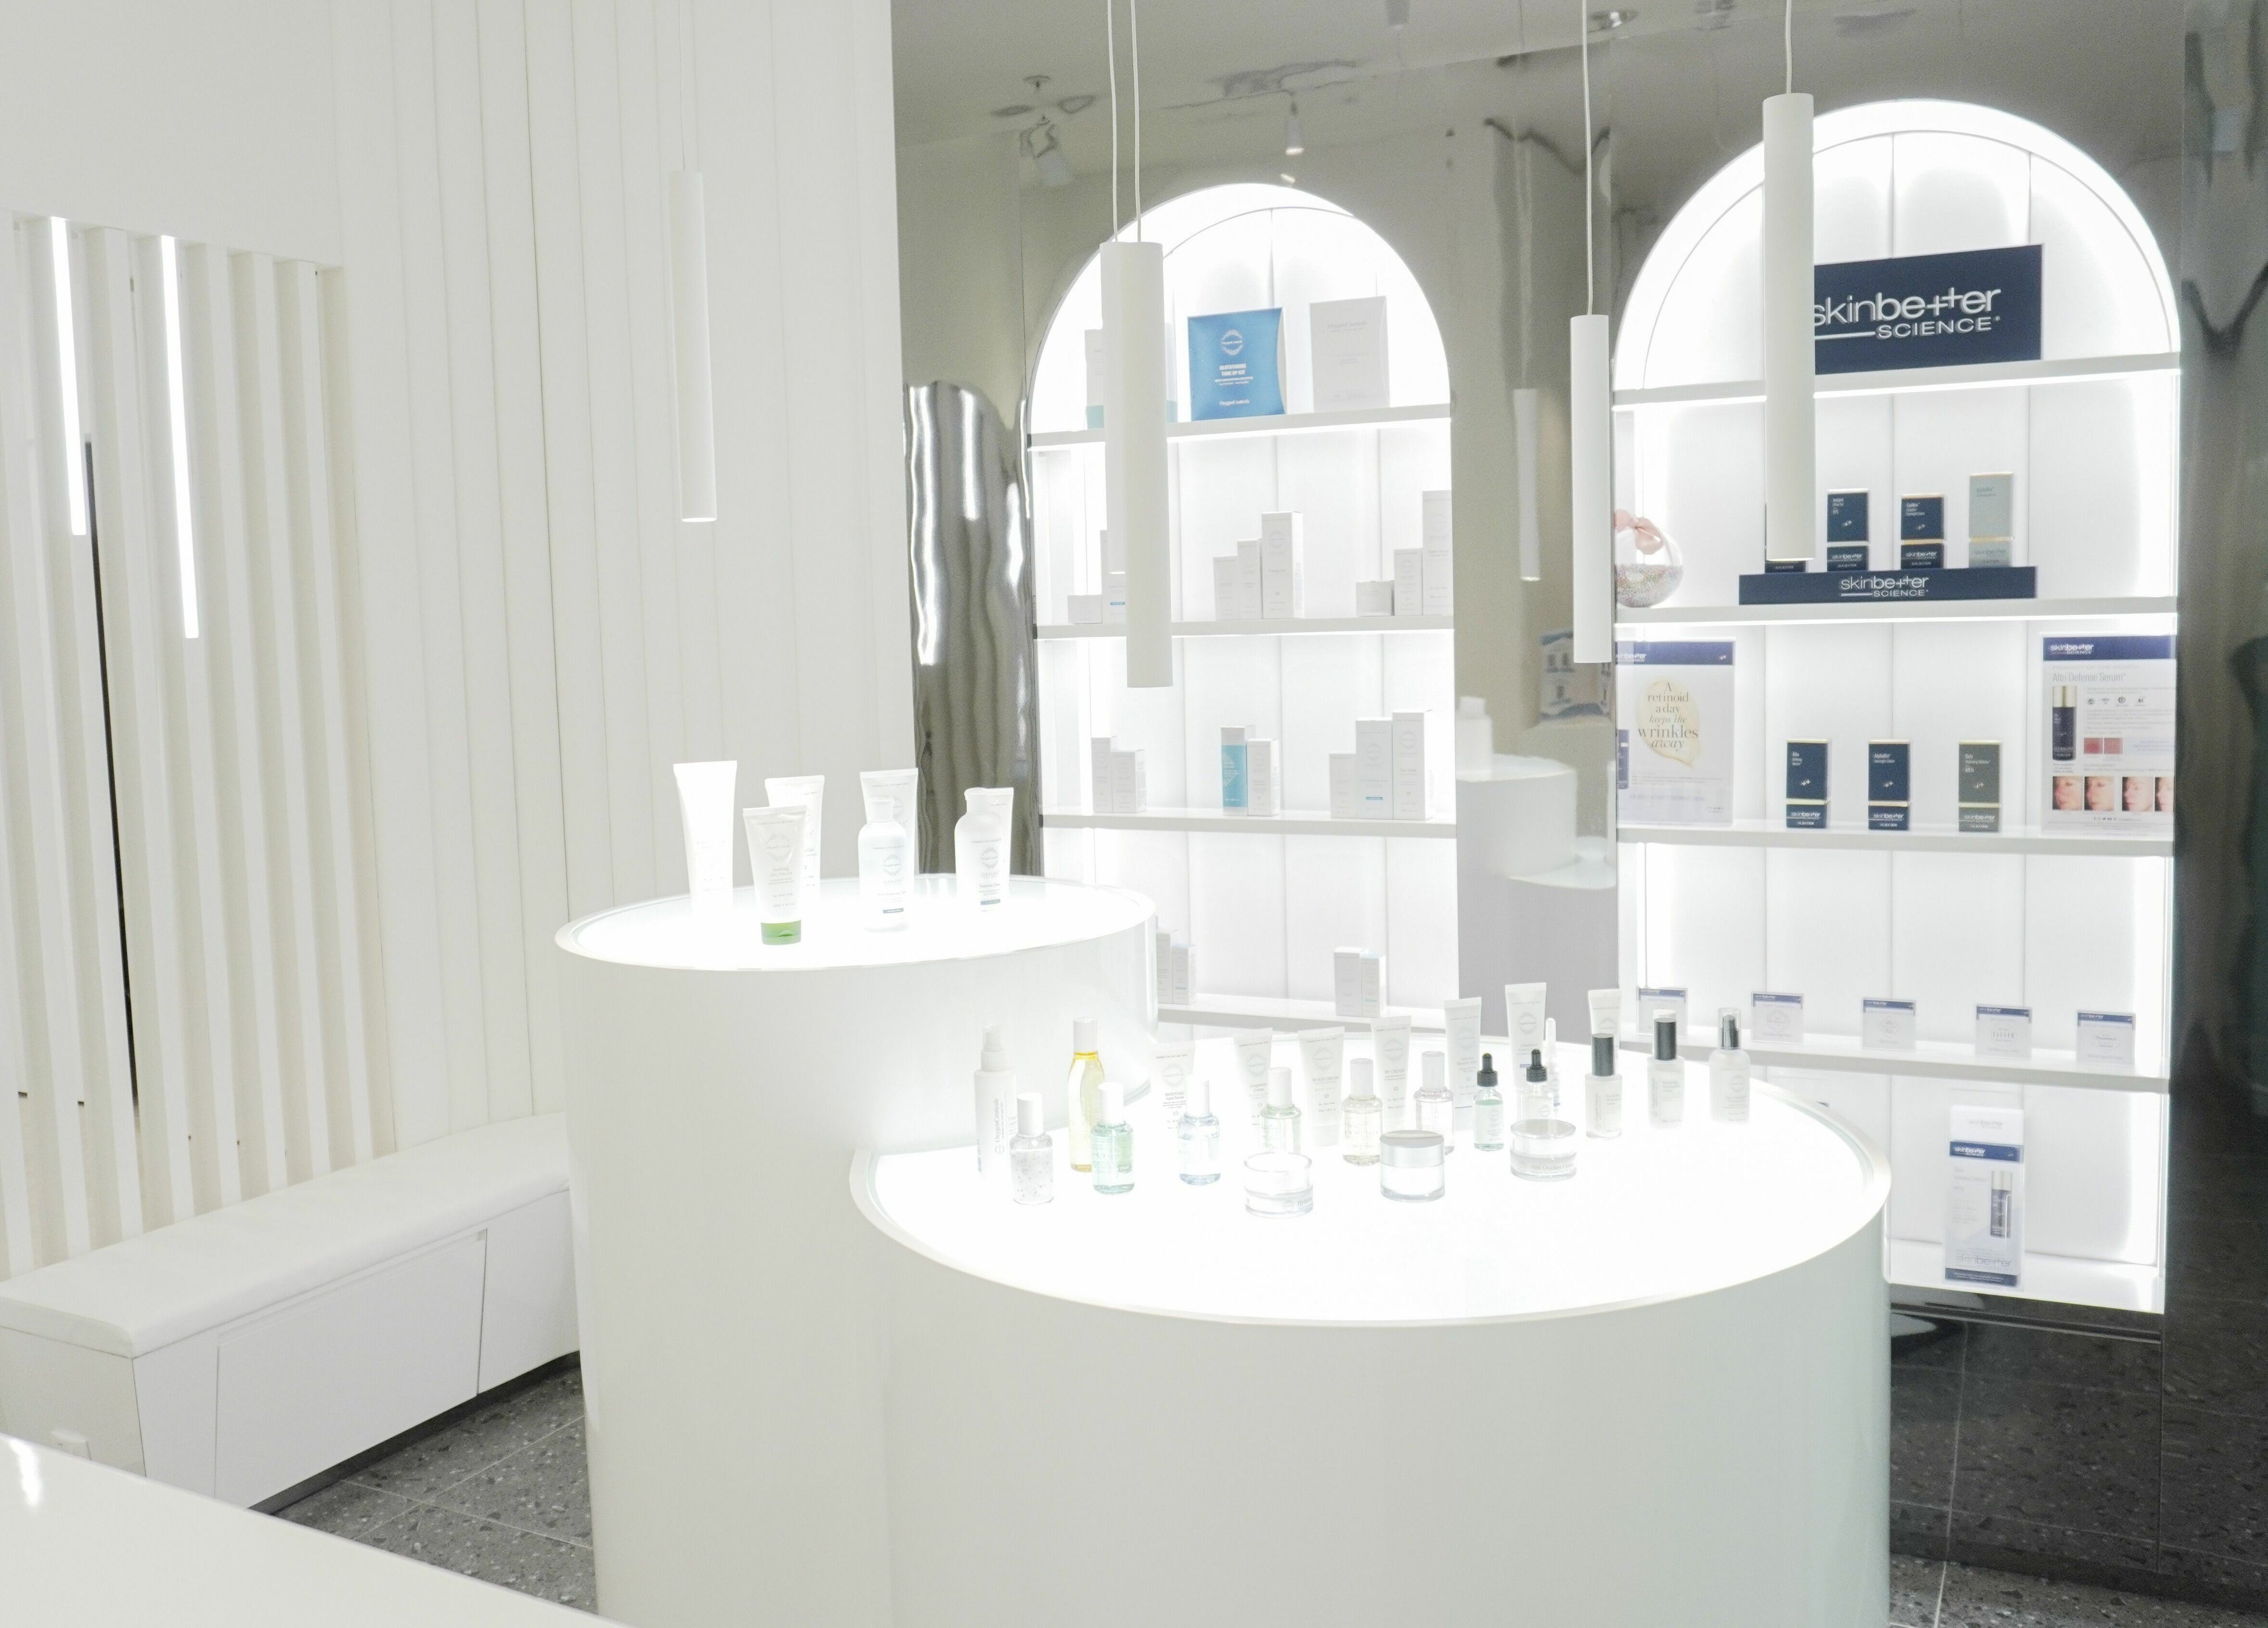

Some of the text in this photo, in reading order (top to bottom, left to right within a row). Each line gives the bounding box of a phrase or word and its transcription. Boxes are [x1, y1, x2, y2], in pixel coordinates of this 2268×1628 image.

[1814, 287, 2001, 326] skinbetter
[1876, 317, 1992, 339] SCIENCE
[1840, 575, 1930, 590] skinbetter
[2050, 643, 2094, 652] skinbetter
[2052, 672, 2067, 682] Alto
[2068, 672, 2098, 681] Defense
[1664, 682, 1672, 692] A
[1648, 692, 1689, 702] retinoid
[1649, 715, 1687, 725] keeps the
[1638, 725, 1699, 738] wrinkles
[1651, 740, 1684, 751] away
[1956, 1255, 2012, 1267] skinbetter
